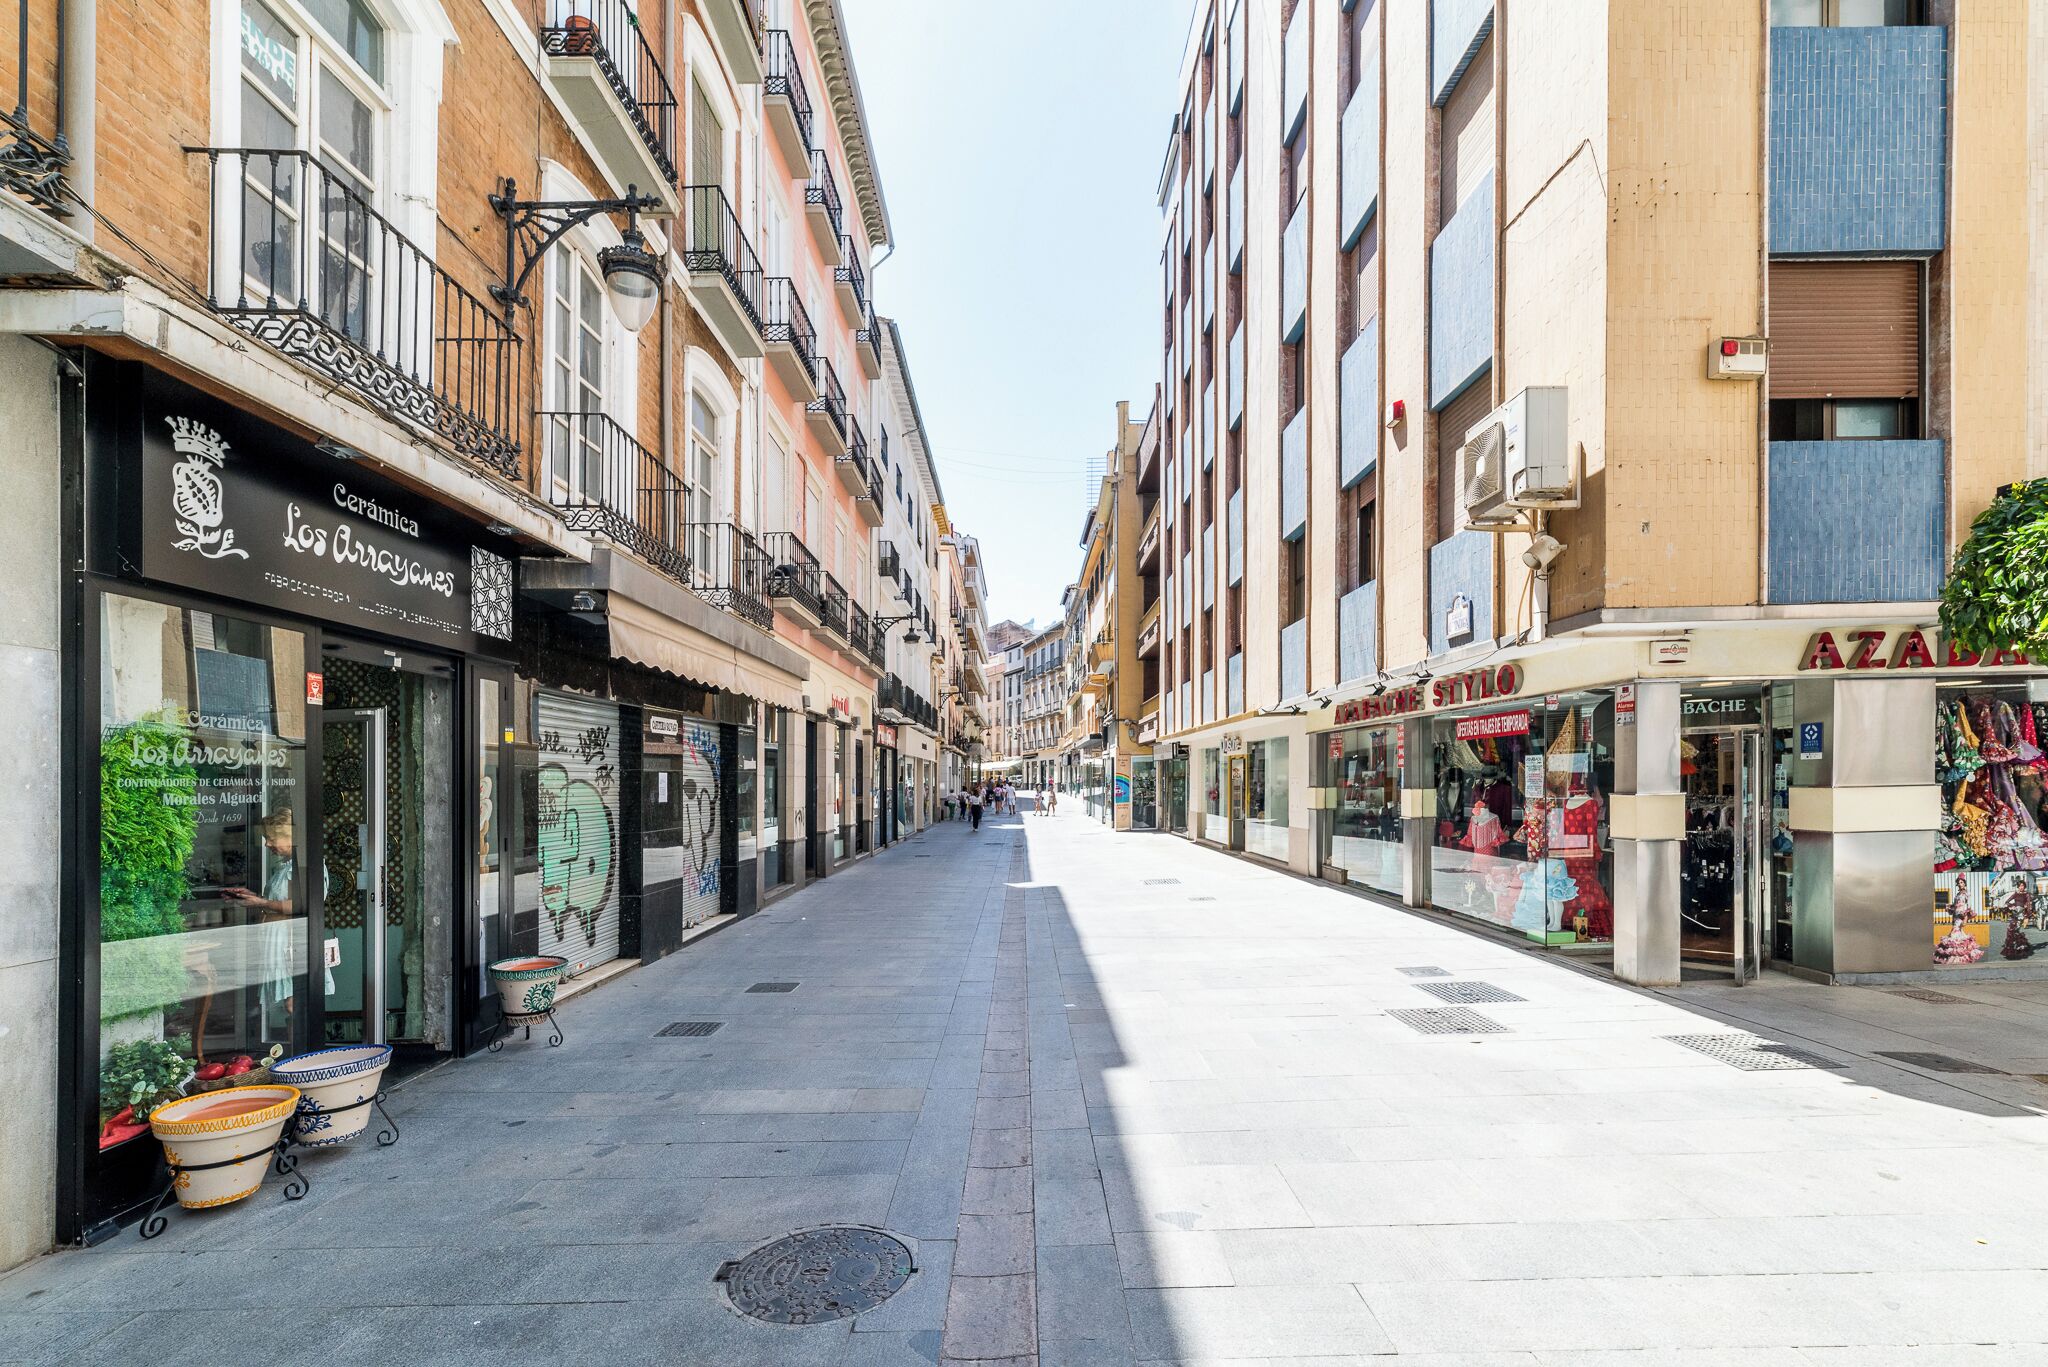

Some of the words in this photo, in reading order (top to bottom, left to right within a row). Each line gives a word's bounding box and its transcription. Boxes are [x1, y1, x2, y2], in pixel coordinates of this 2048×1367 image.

[333, 483, 420, 538] Cerámica
[282, 502, 328, 557] Los
[333, 524, 455, 598] Arrayanes
[1334, 686, 1422, 725] AZABACHE
[1433, 664, 1520, 707] STYLO
[1680, 699, 1746, 714] BACHE
[188, 711, 264, 731] Cerámica
[1456, 720, 1473, 738] OFERTAS
[1474, 719, 1480, 736] EN
[1480, 717, 1495, 735] TRAJES
[1495, 716, 1502, 733] DE
[1502, 713, 1528, 732] TEMPORADA
[130, 734, 168, 768] Los
[173, 737, 288, 770] Arrayanes
[117, 778, 197, 788] CONTINUADORES
[200, 778, 211, 787] DE
[214, 776, 253, 787] CERÁMICA
[255, 778, 269, 786] SAN
[271, 777, 296, 786] ISIDRO
[163, 792, 216, 806] Morales
[195, 811, 219, 824] Desde
[222, 813, 242, 823] 1659
